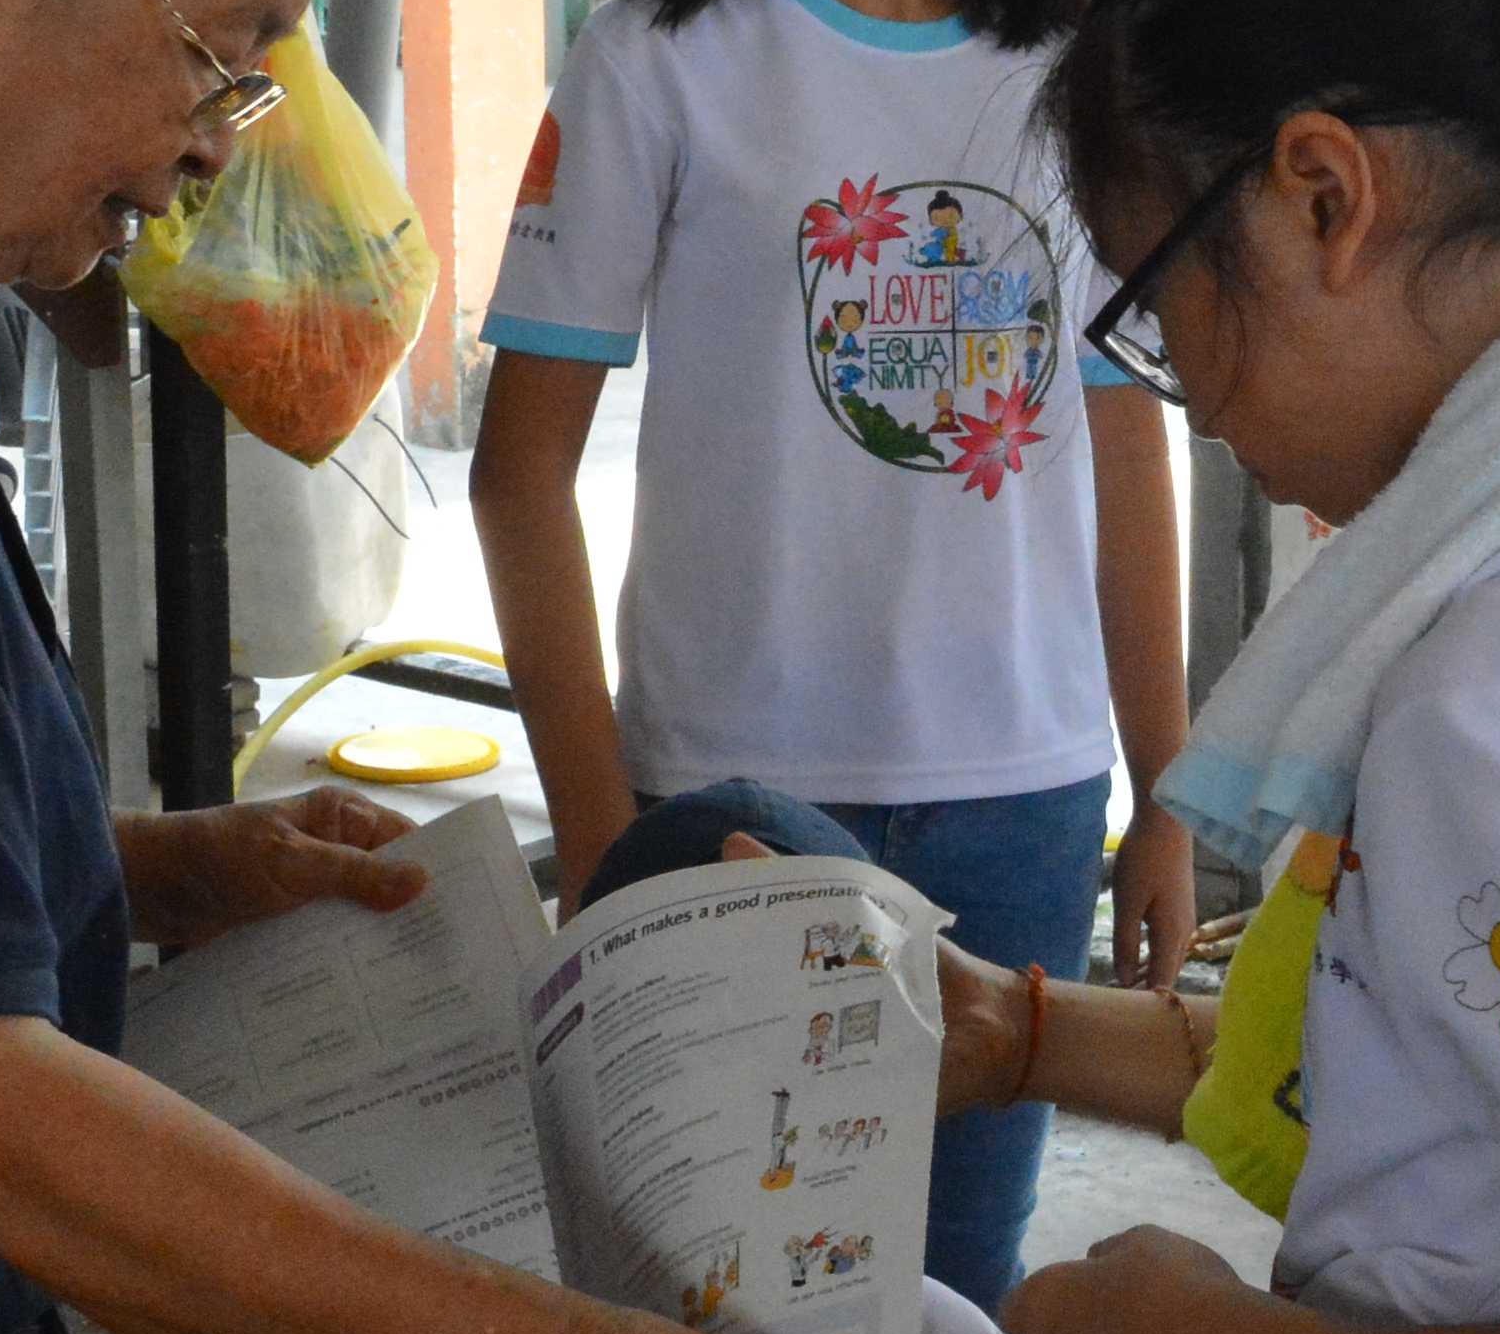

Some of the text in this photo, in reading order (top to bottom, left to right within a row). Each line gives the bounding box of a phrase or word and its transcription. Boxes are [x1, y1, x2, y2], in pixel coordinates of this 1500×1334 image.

[869, 275, 949, 325] LOVE
[869, 336, 949, 365] EQUA
[869, 364, 949, 391] NIMITY
[588, 947, 601, 966] 1.
[602, 927, 637, 956] What
[640, 908, 693, 939] makes
[699, 905, 709, 919] a
[715, 892, 761, 919] good
